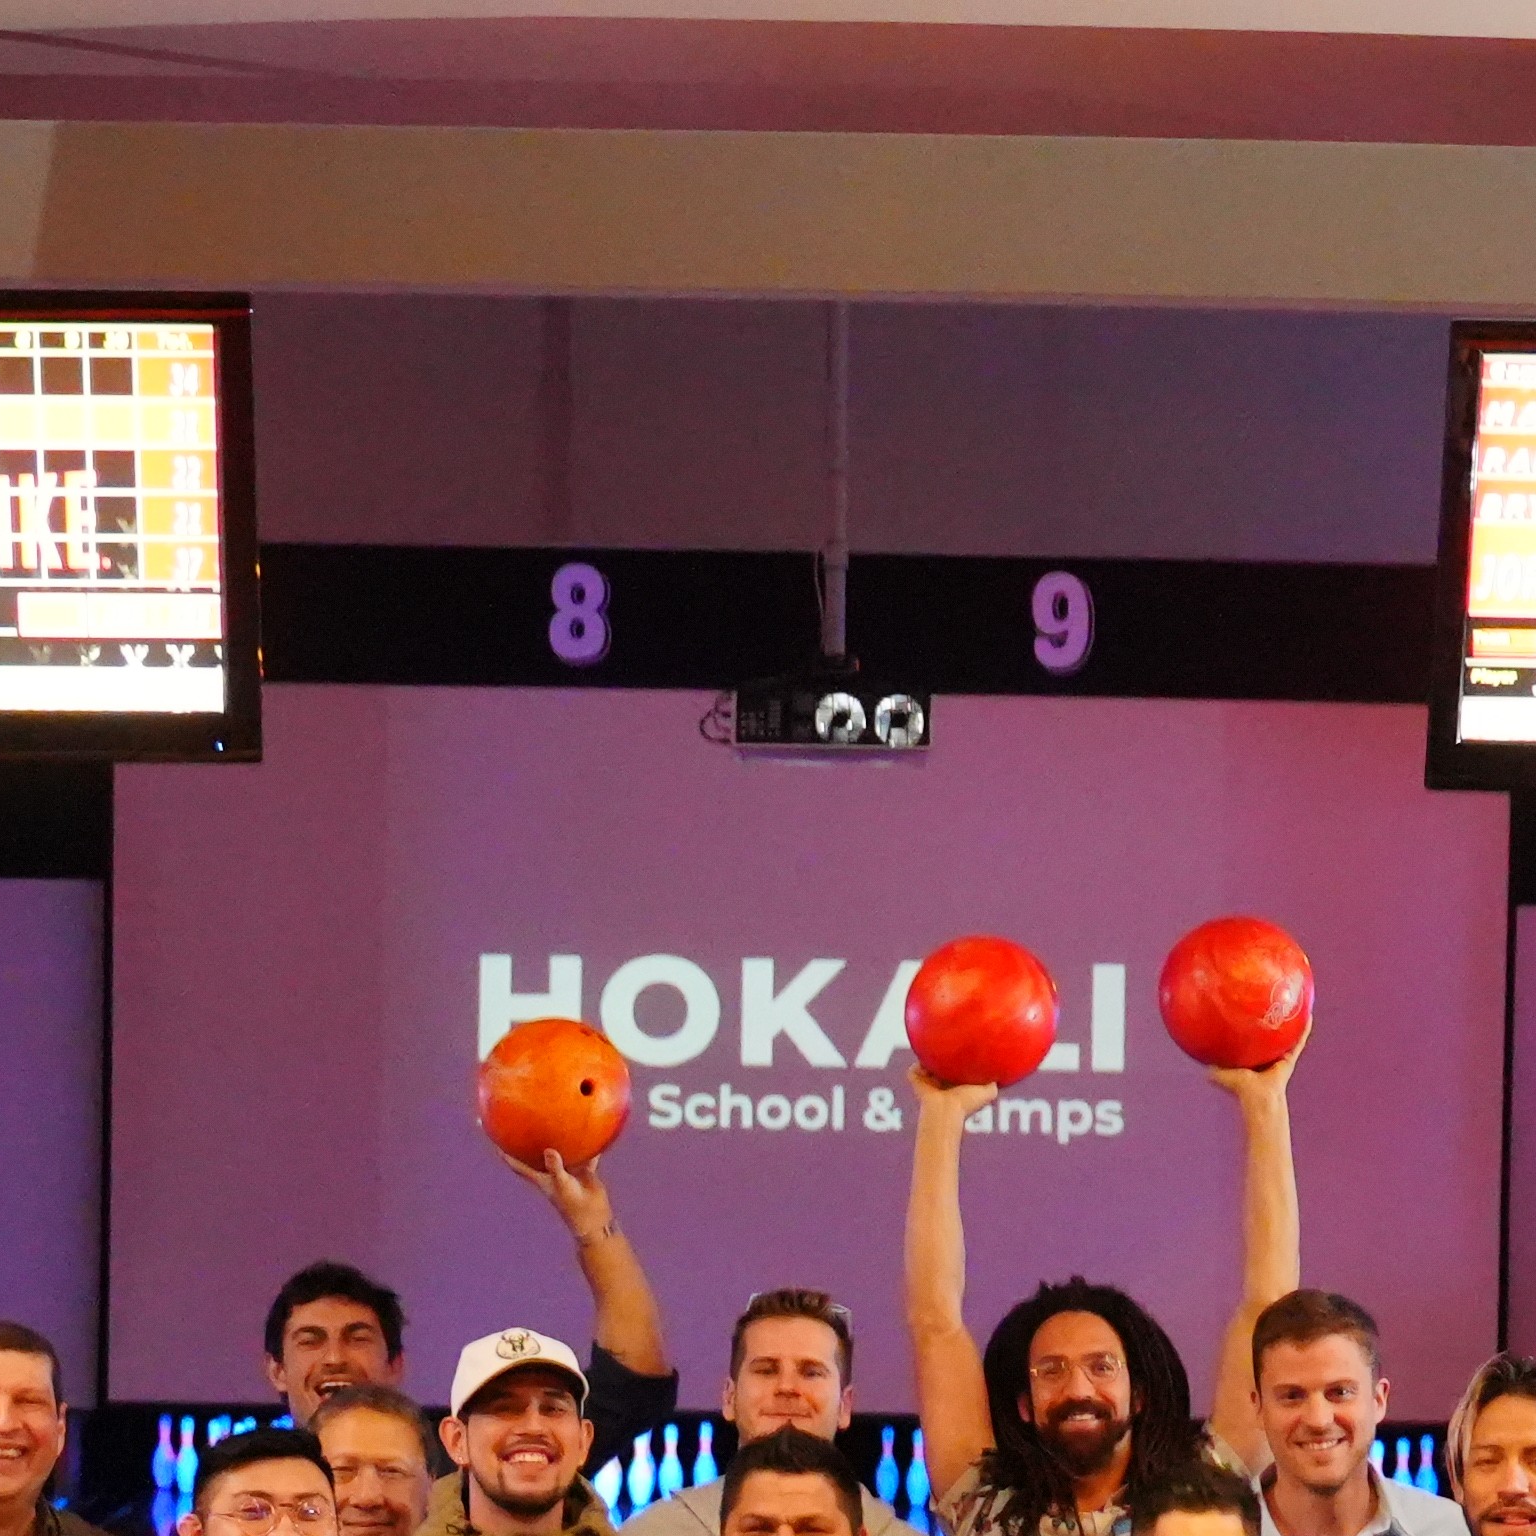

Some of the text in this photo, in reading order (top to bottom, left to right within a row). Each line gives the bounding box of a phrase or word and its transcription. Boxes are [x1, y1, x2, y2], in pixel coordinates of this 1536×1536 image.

[549, 561, 611, 667] 8
[1032, 570, 1096, 673] 9
[1470, 667, 1519, 688] Player
[648, 1083, 1124, 1144] School & amps
